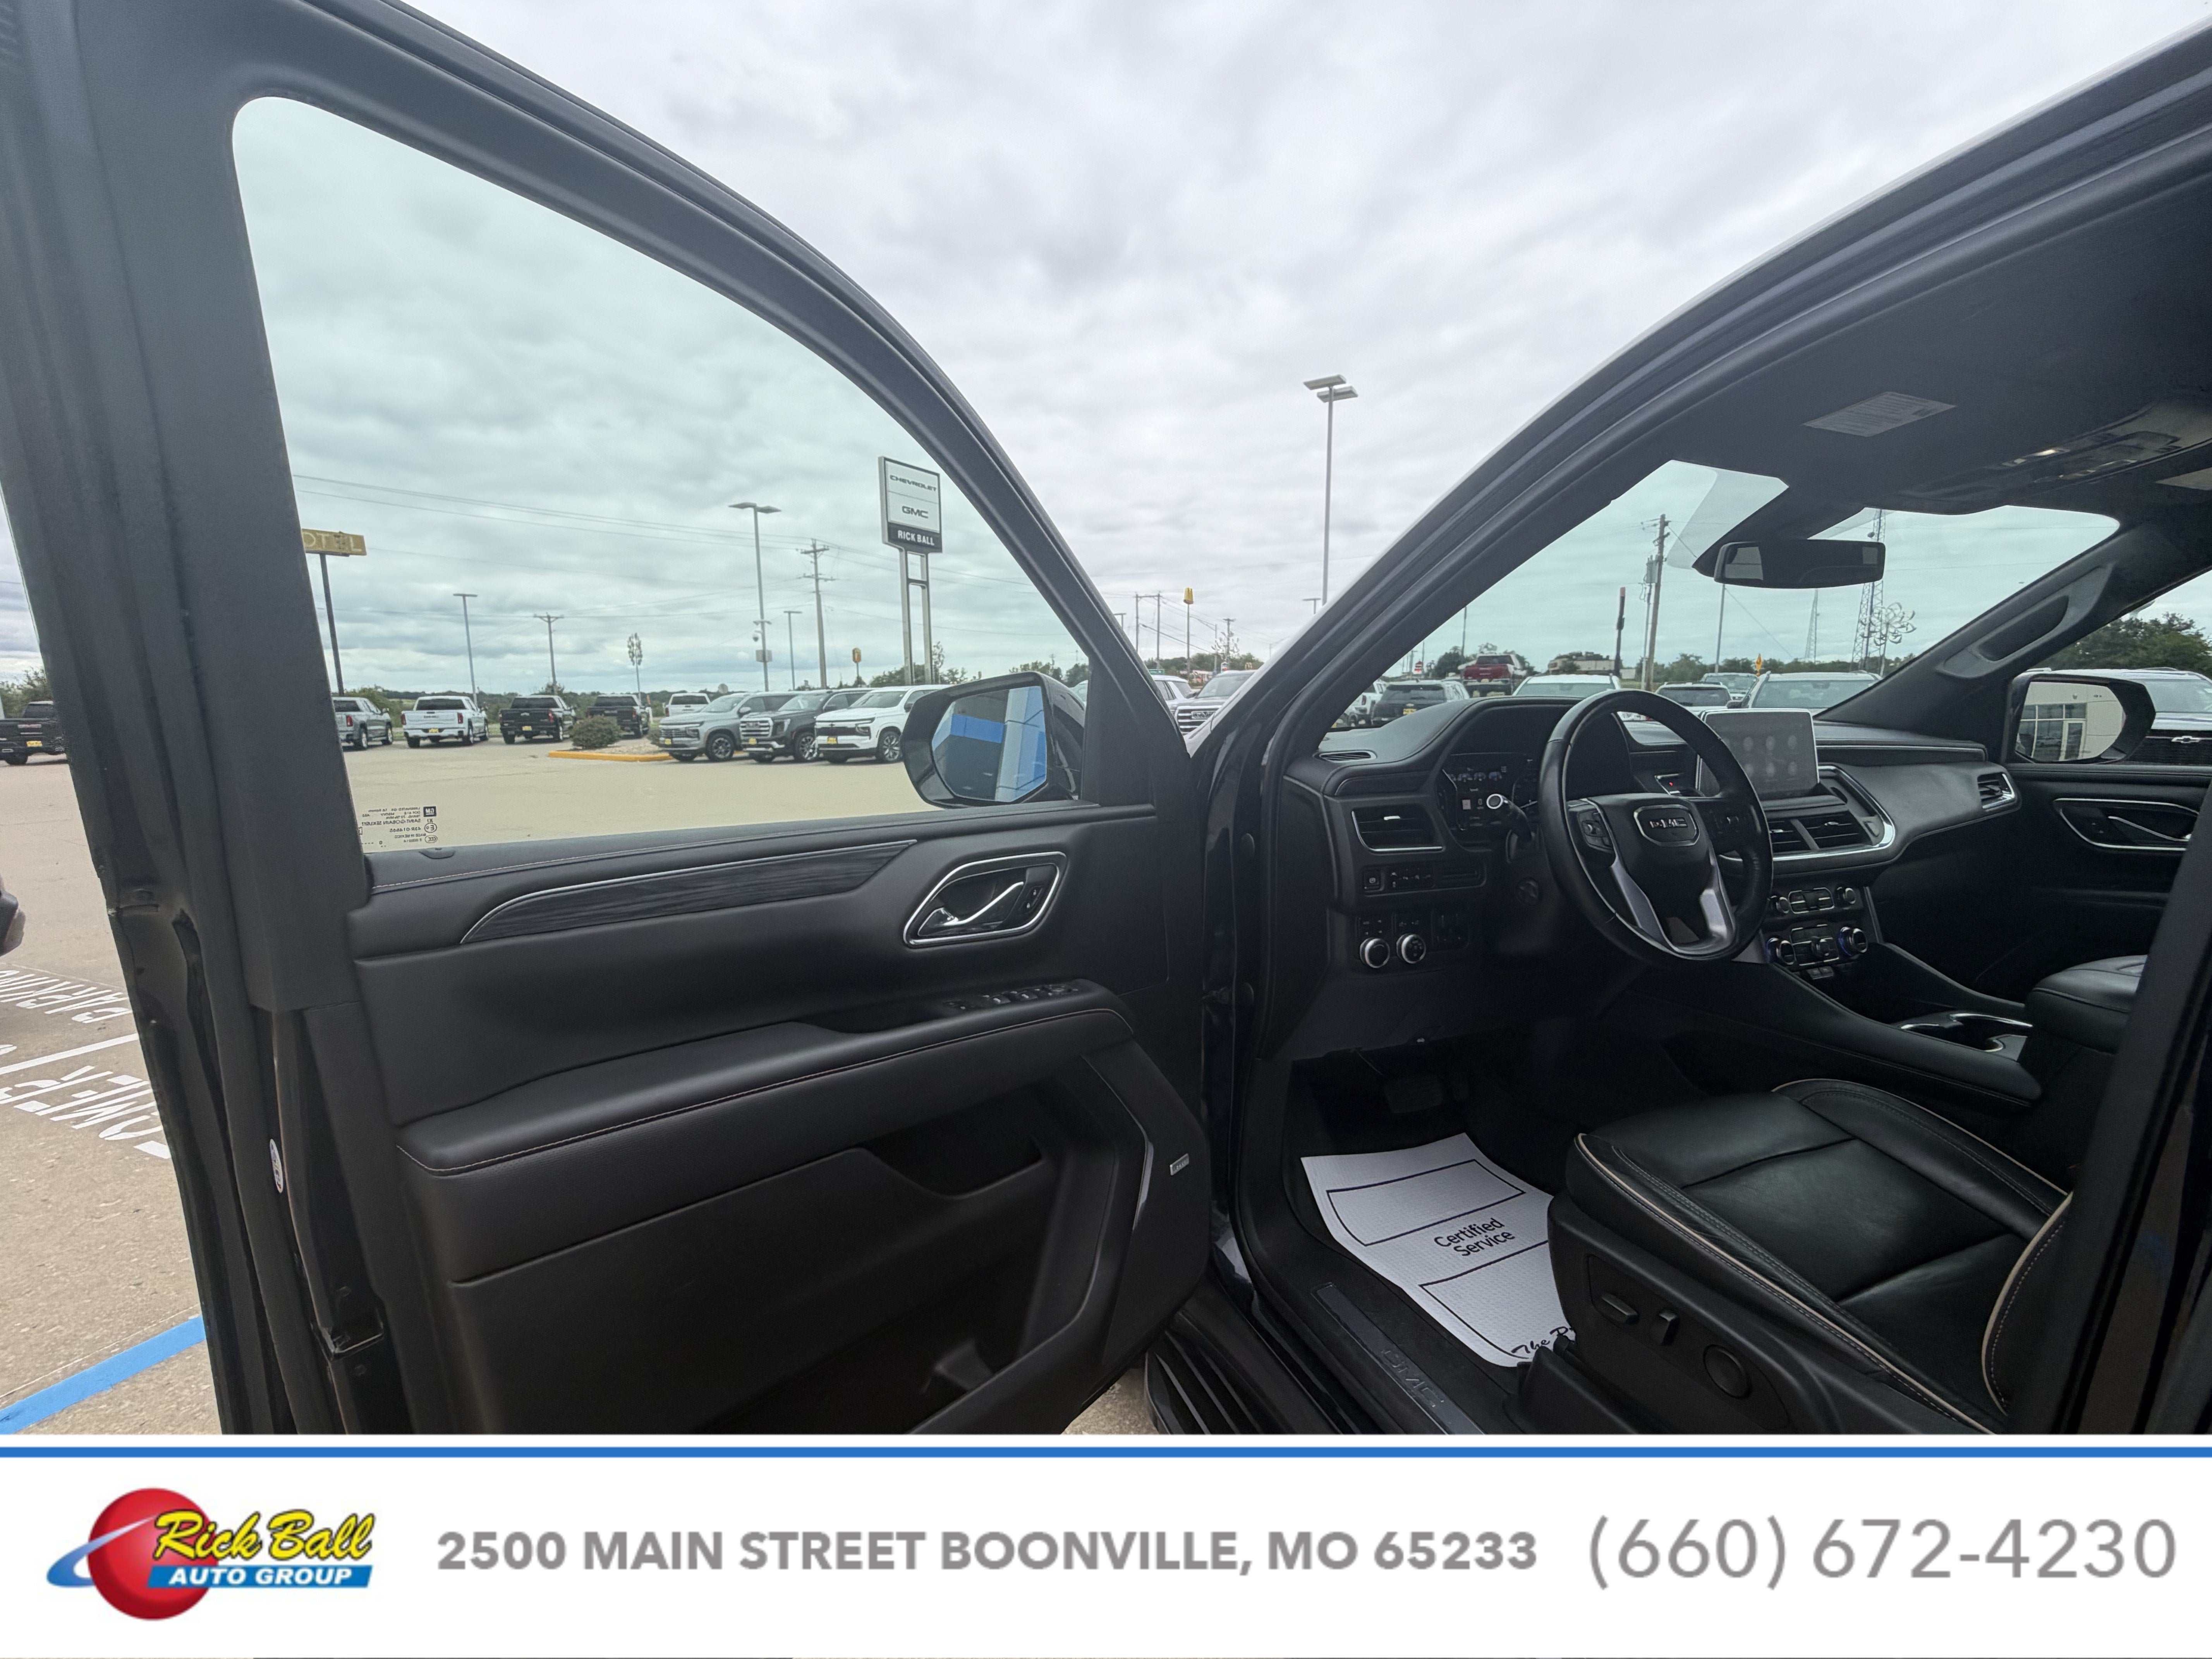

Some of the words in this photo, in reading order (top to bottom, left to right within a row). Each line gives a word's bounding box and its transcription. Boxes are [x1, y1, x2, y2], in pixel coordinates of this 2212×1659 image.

[890, 475, 936, 491] CHEVROLET
[902, 505, 929, 519] GMC
[897, 530, 916, 542] RICK
[917, 534, 935, 546] BALL
[1434, 1218, 1505, 1247] Certified
[1453, 1230, 1515, 1257] Service
